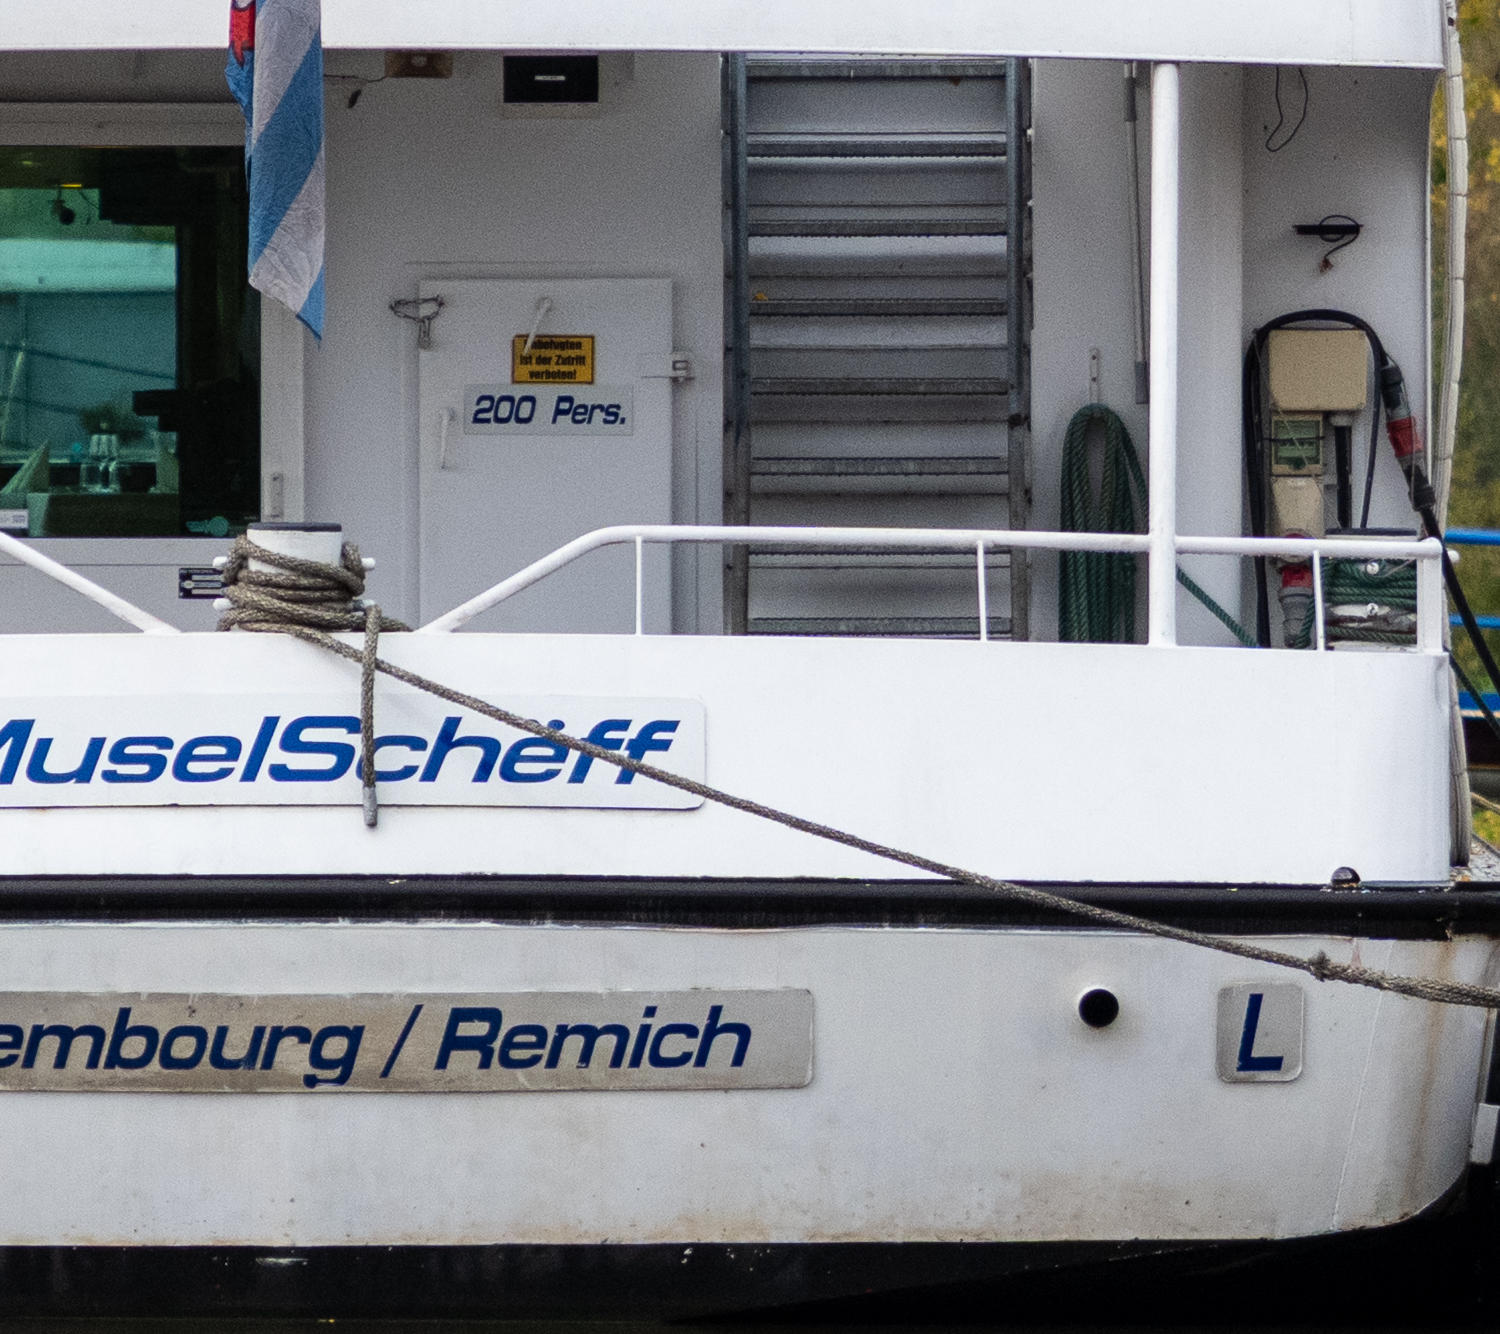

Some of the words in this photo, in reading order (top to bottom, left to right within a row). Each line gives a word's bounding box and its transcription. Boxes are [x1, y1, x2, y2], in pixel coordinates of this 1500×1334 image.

[528, 369, 577, 380] verboten!
[535, 354, 553, 366] der
[554, 354, 586, 366] Zutritt
[471, 394, 537, 424] 200
[551, 395, 626, 425] Pers.
[379, 1003, 425, 1079] /
[433, 1004, 752, 1071] Remich
[1236, 993, 1284, 1072] L
